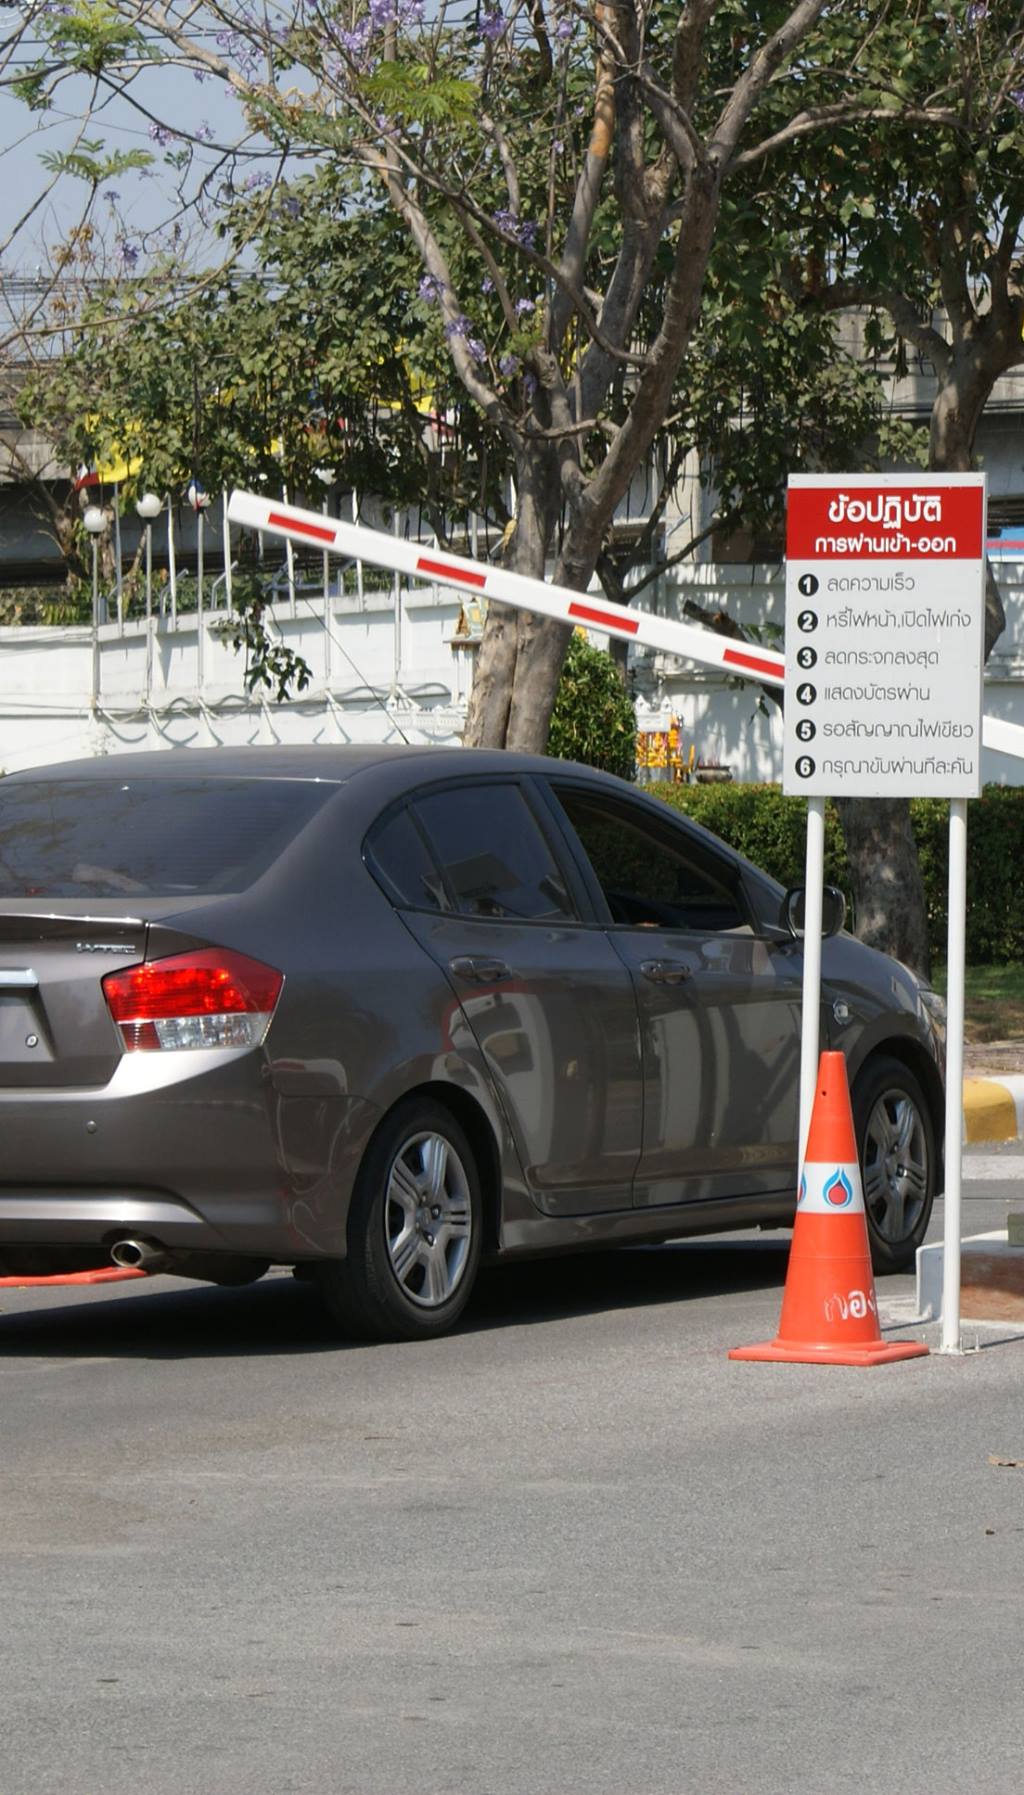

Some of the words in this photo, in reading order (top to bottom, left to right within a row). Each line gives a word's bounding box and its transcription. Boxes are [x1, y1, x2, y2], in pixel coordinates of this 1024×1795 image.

[828, 494, 942, 529] ข้อปฏิบัติ
[814, 533, 957, 553] การผ่านเข้า-ออก
[827, 572, 915, 592] ลดความเร็ว
[824, 650, 939, 669] ลดกระจกลงสุด
[824, 683, 931, 701] แสดงบัตรผ่าน
[823, 719, 975, 738] รอสัญญาณไฟเขียว
[822, 756, 974, 778] กรุณาขับผ่านทีละคัน
